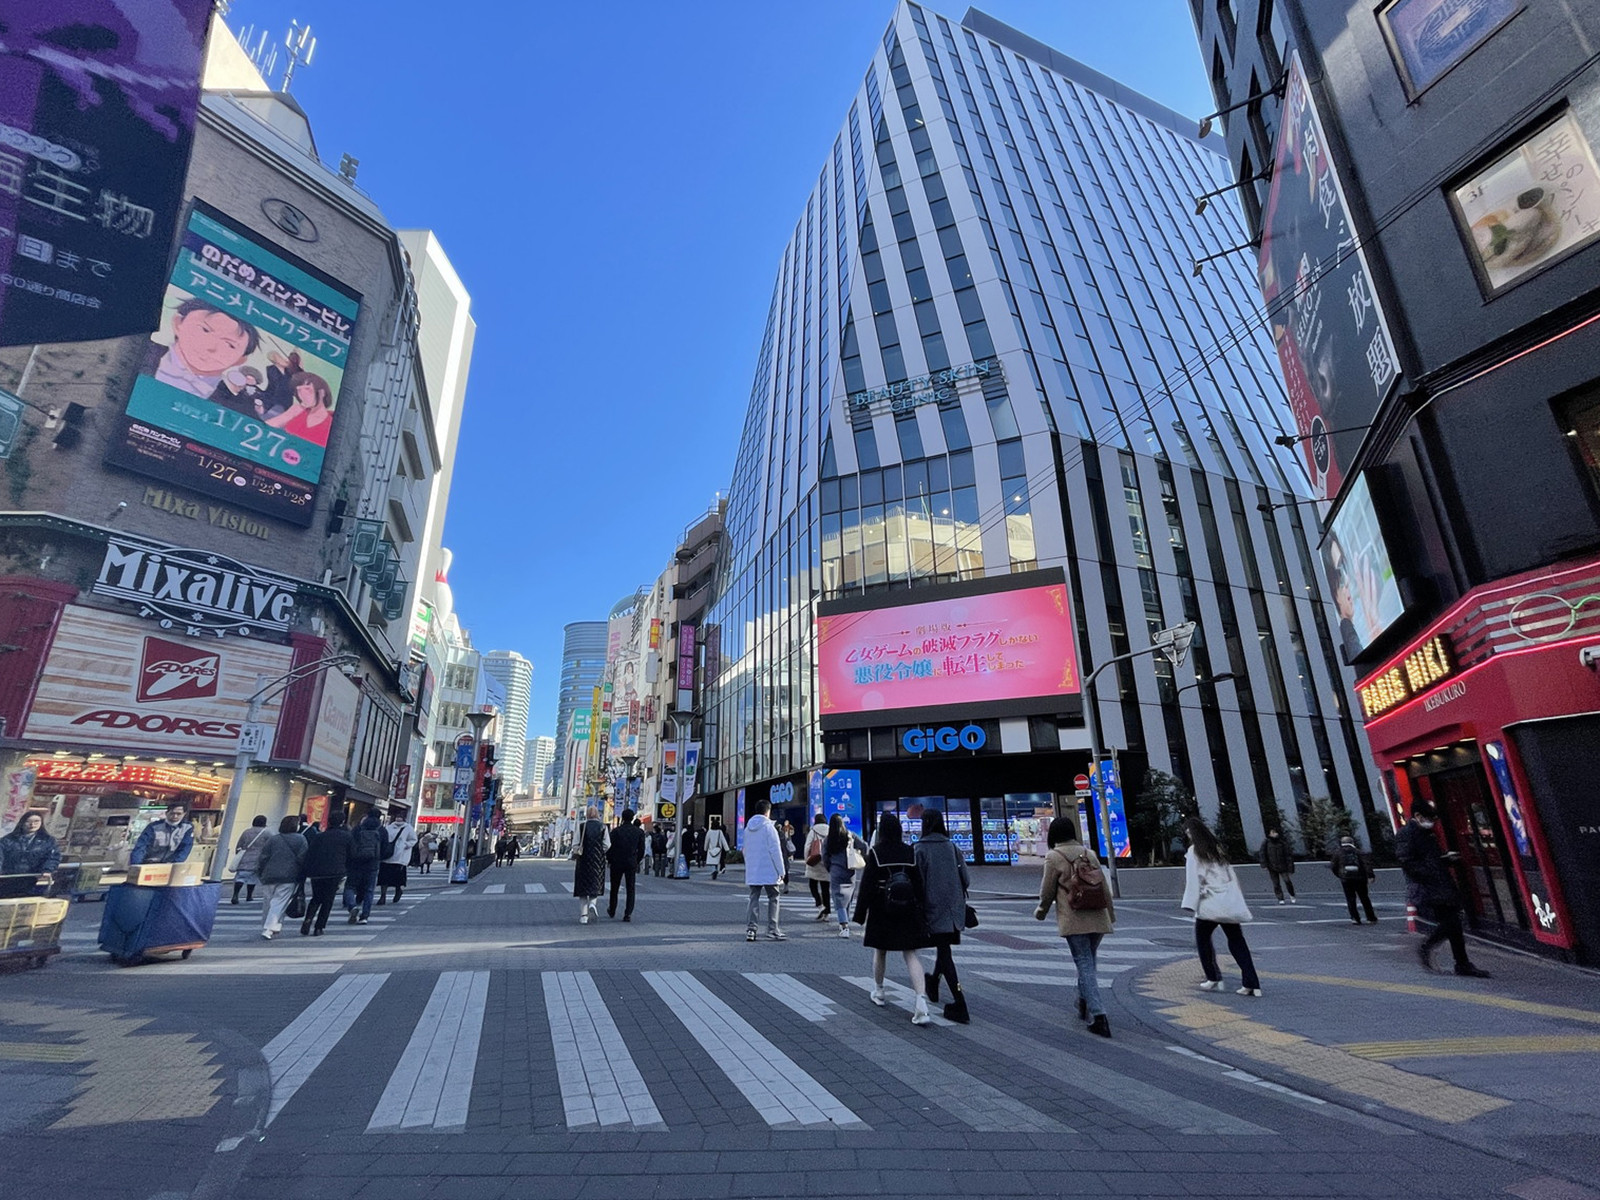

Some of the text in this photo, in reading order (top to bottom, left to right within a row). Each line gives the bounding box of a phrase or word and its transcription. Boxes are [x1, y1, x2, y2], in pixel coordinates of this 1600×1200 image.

[201, 244, 350, 332] のだめ カンタービレ
[190, 270, 346, 357] アニメトークライブ
[855, 359, 990, 406] BEAUTY SKIN
[890, 387, 951, 413] CLINIC
[214, 407, 287, 458] 1/27
[142, 486, 269, 541] Mixa Vision
[97, 543, 295, 623] Mixalive
[845, 628, 1039, 664] 乙女ゲームの破滅フラグしかない
[915, 623, 952, 637] 劇場版
[145, 659, 217, 678] ADORES
[1361, 635, 1450, 717] PARIS MIKI
[1423, 680, 1467, 712] IKEBUKURO
[70, 709, 243, 740] ADORES
[902, 725, 987, 754] GiGO
